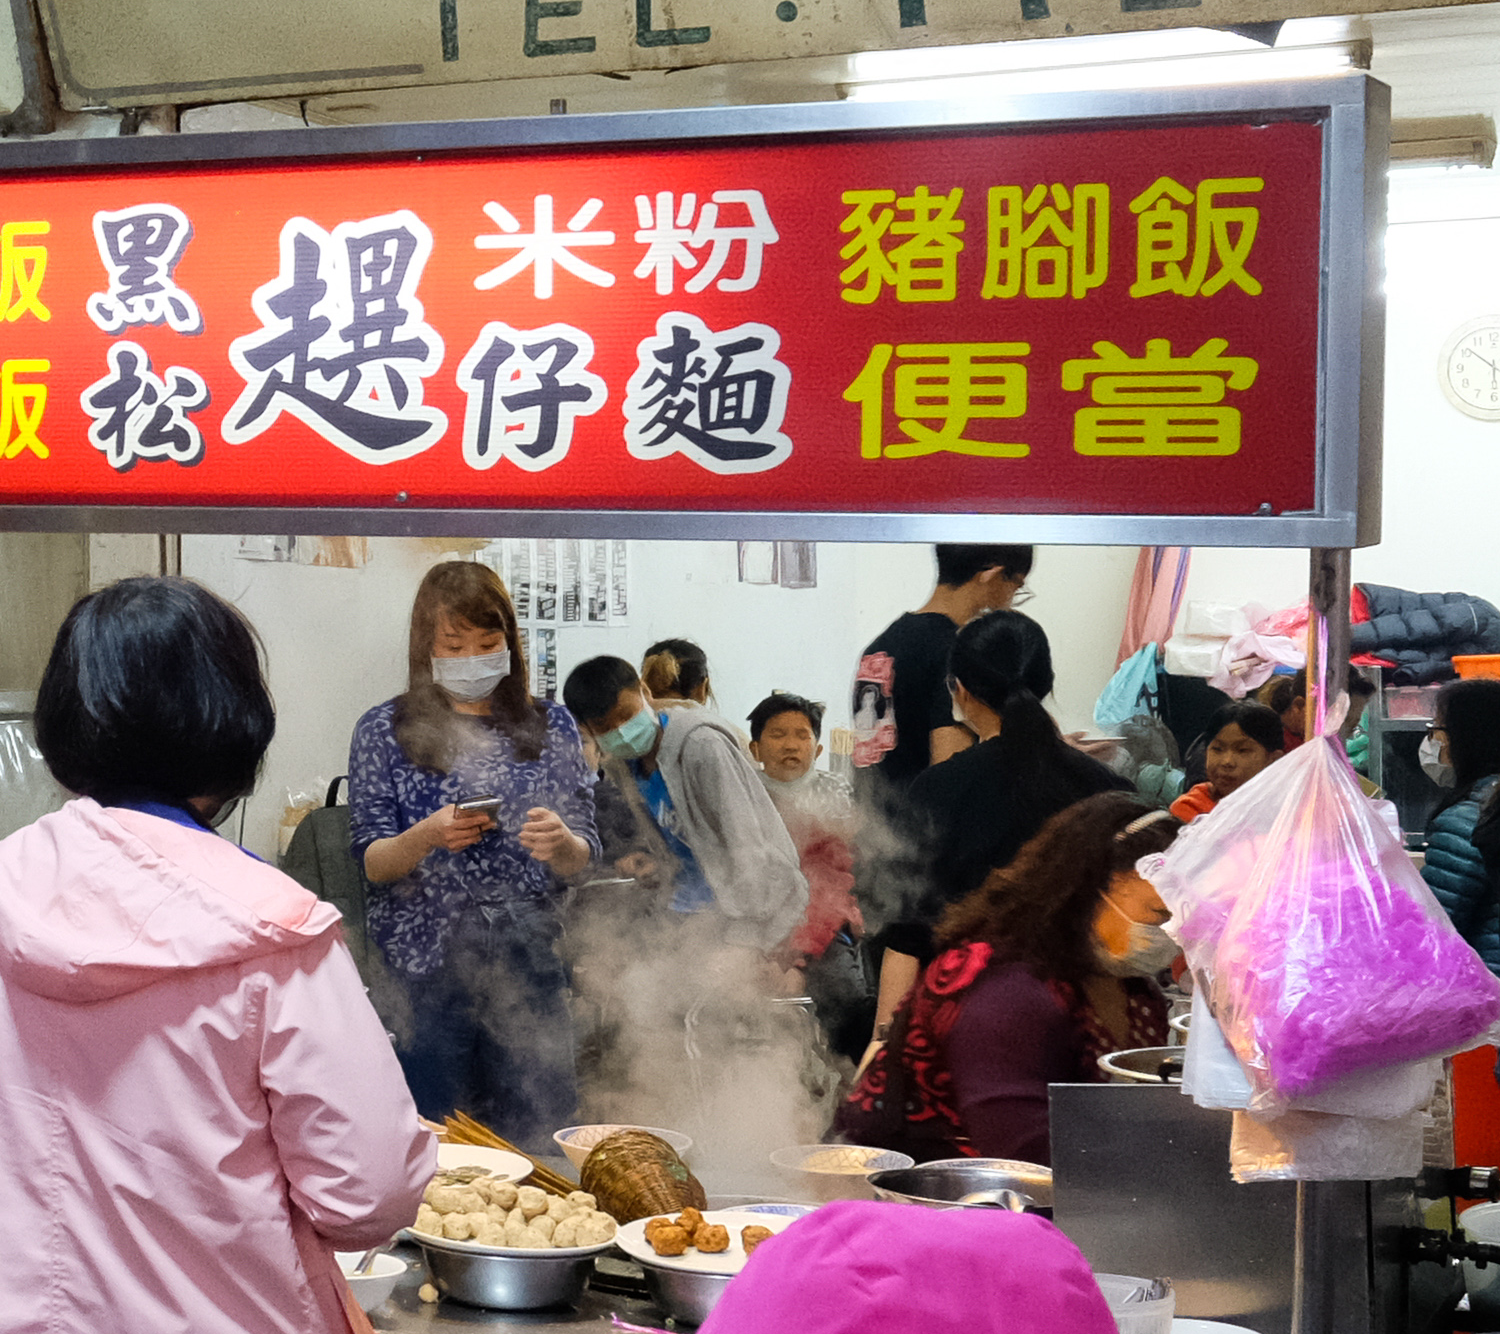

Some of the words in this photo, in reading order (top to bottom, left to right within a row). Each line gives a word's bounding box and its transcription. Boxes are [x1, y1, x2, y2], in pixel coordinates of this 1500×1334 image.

[474, 188, 780, 300] 米粉
[839, 176, 1265, 304] 豬腳飯
[81, 204, 211, 471] 黑松
[843, 338, 1260, 459] 便當
